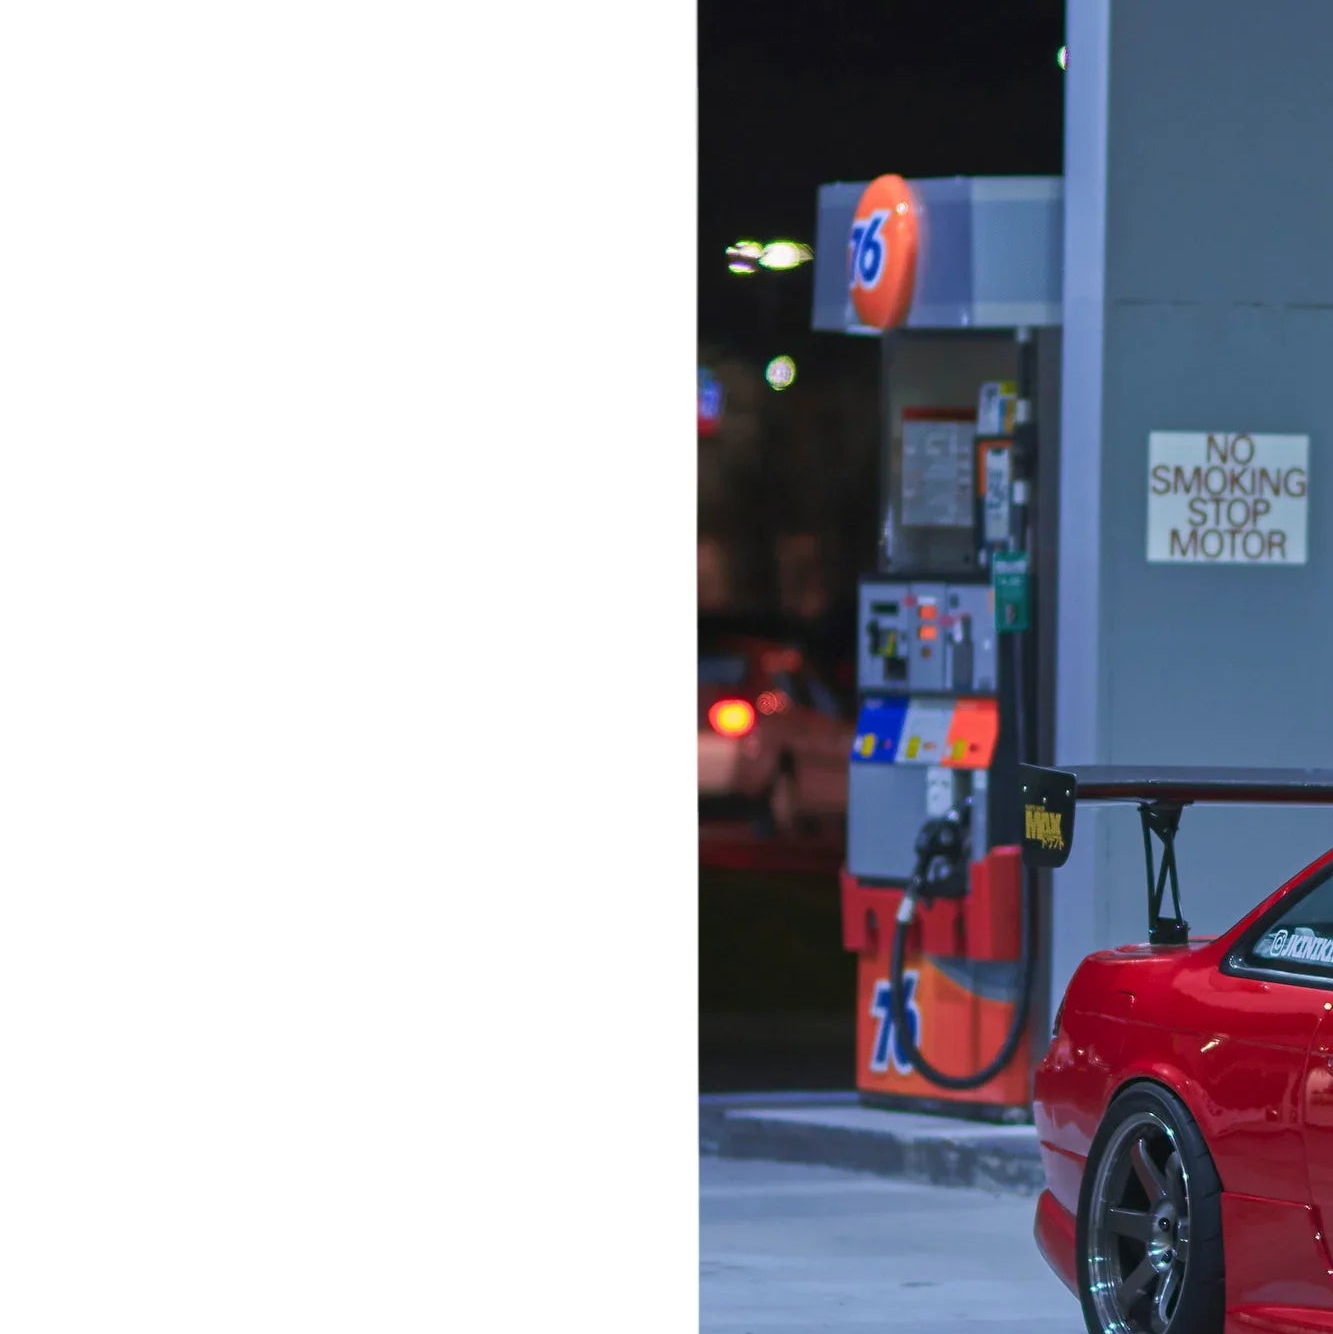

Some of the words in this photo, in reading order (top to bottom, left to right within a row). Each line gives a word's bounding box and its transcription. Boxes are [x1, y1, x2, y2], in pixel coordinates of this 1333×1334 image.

[849, 209, 890, 291] 76
[1206, 433, 1255, 465] NO
[1151, 465, 1307, 498] SMOKING
[1187, 496, 1271, 528] STOP
[1169, 527, 1287, 559] MOTOR
